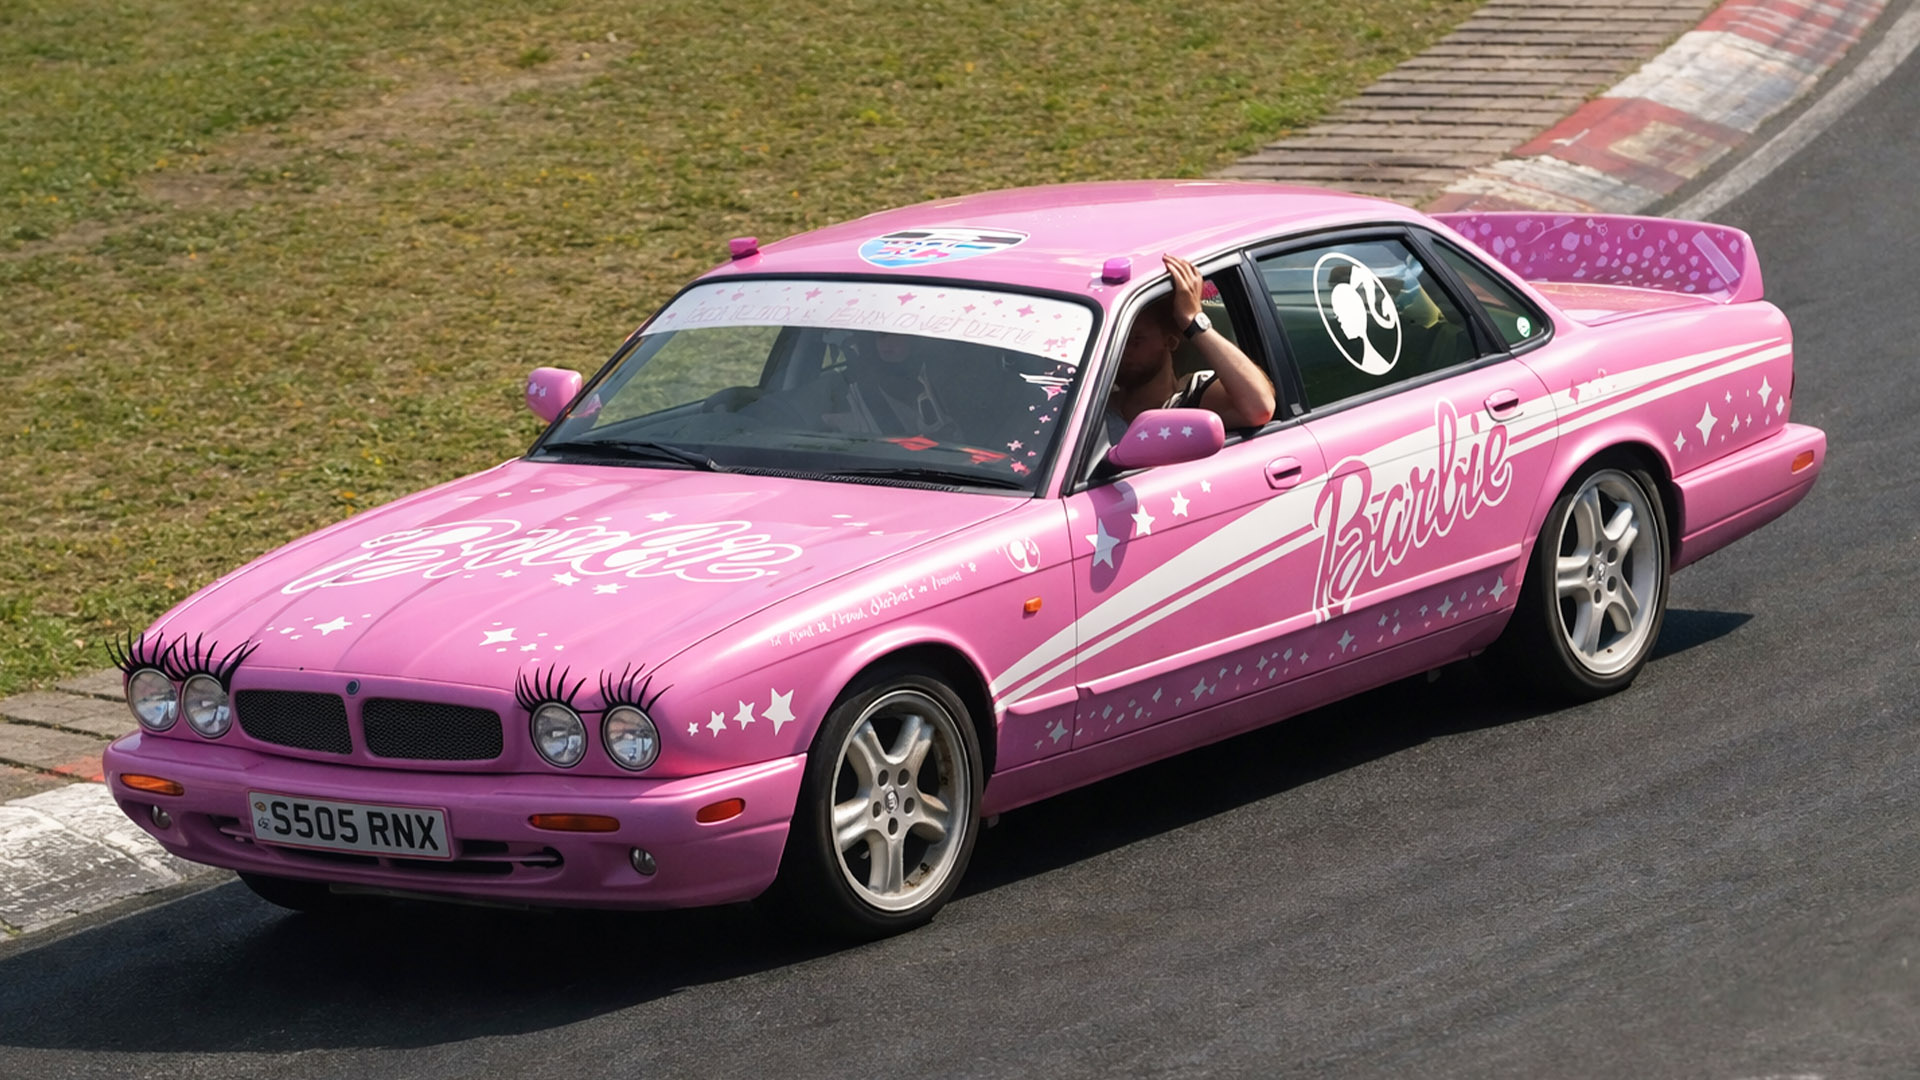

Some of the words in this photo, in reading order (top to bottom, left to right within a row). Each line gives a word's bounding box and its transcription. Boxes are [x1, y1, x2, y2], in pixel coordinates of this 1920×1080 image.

[1313, 396, 1513, 624] Barbie
[270, 801, 359, 844] S505
[366, 811, 439, 851] RNX
